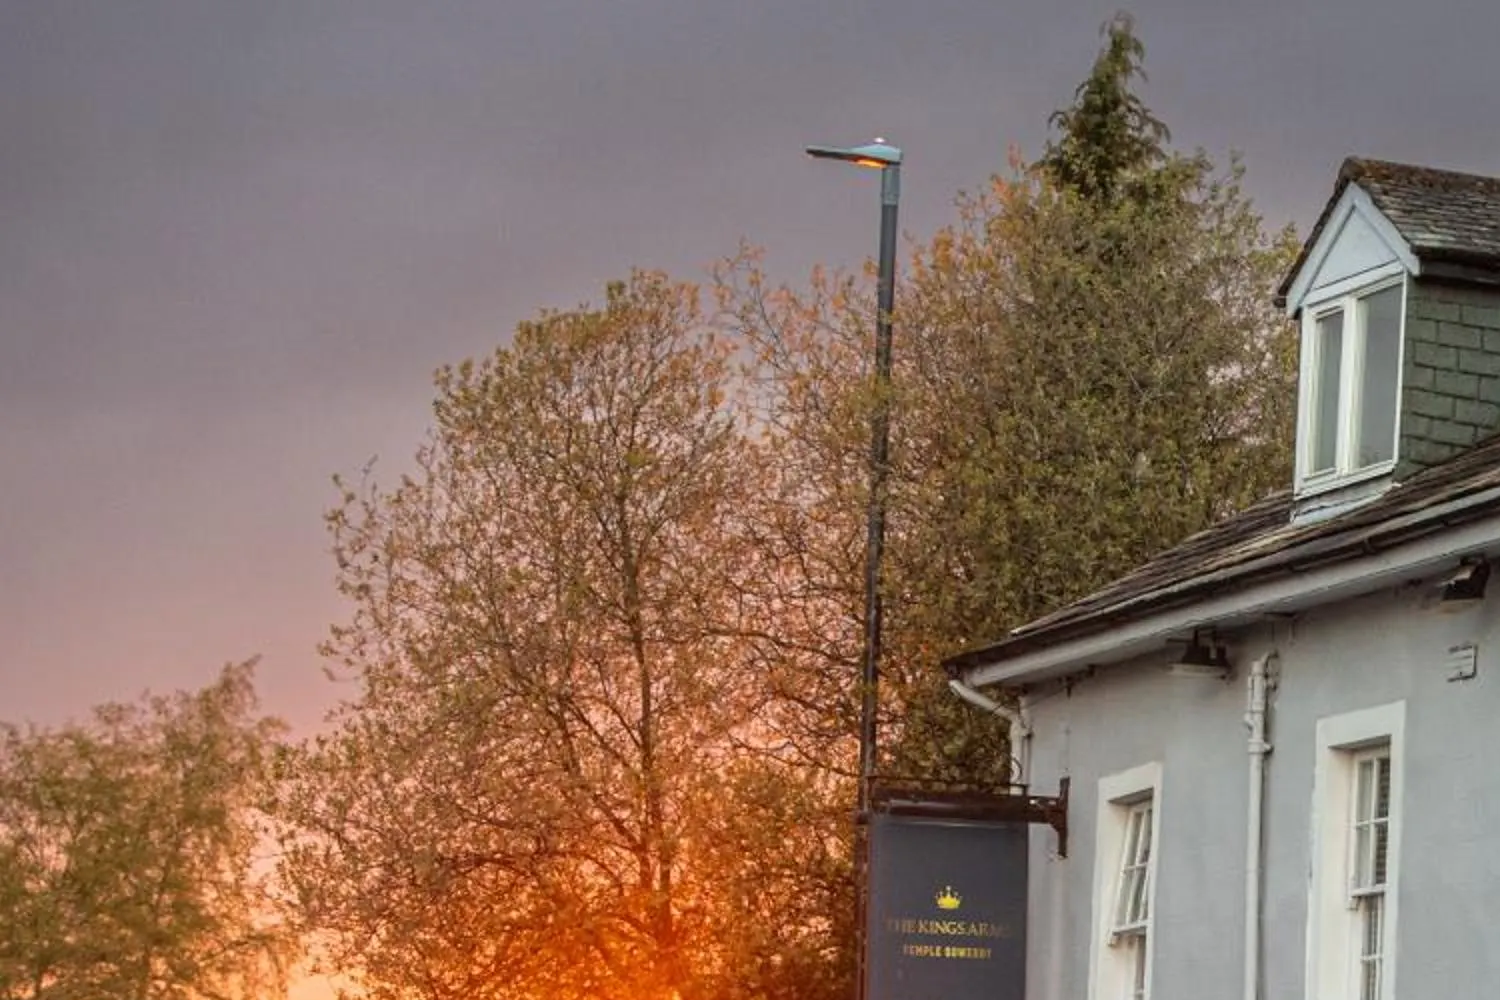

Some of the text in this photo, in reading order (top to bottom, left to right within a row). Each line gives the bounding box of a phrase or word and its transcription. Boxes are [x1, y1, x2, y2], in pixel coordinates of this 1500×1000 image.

[886, 918, 916, 934] THE
[918, 918, 965, 935] KINGS
[903, 944, 941, 957] TEMPLE
